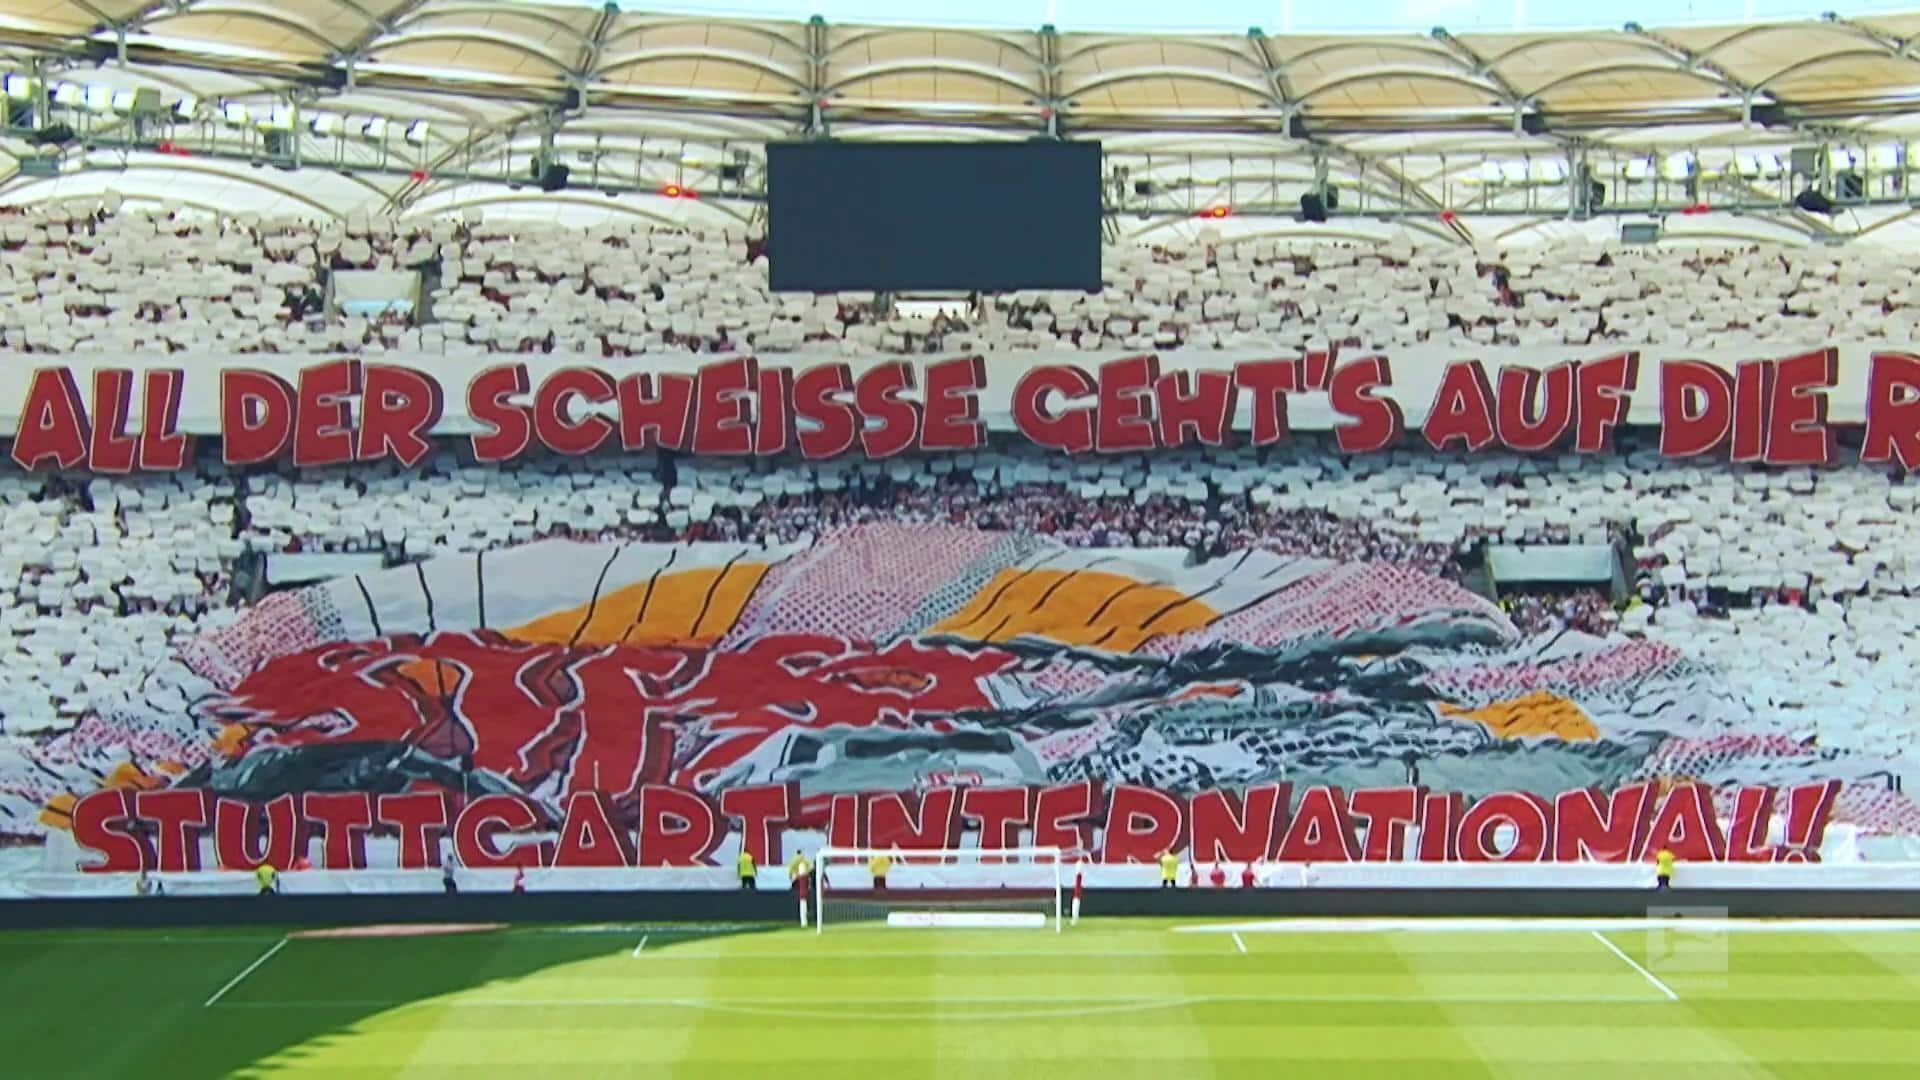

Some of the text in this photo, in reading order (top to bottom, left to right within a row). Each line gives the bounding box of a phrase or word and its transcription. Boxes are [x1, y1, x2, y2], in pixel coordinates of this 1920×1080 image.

[11, 364, 192, 473] ALL
[219, 358, 444, 470] DER
[467, 353, 988, 462] SCHEISSE
[1010, 341, 1402, 456] GEHT'S
[1421, 350, 1640, 454] AUF
[1659, 347, 1839, 465] DIE
[71, 778, 1843, 874] STUTTGART INTERNATIONAL!
